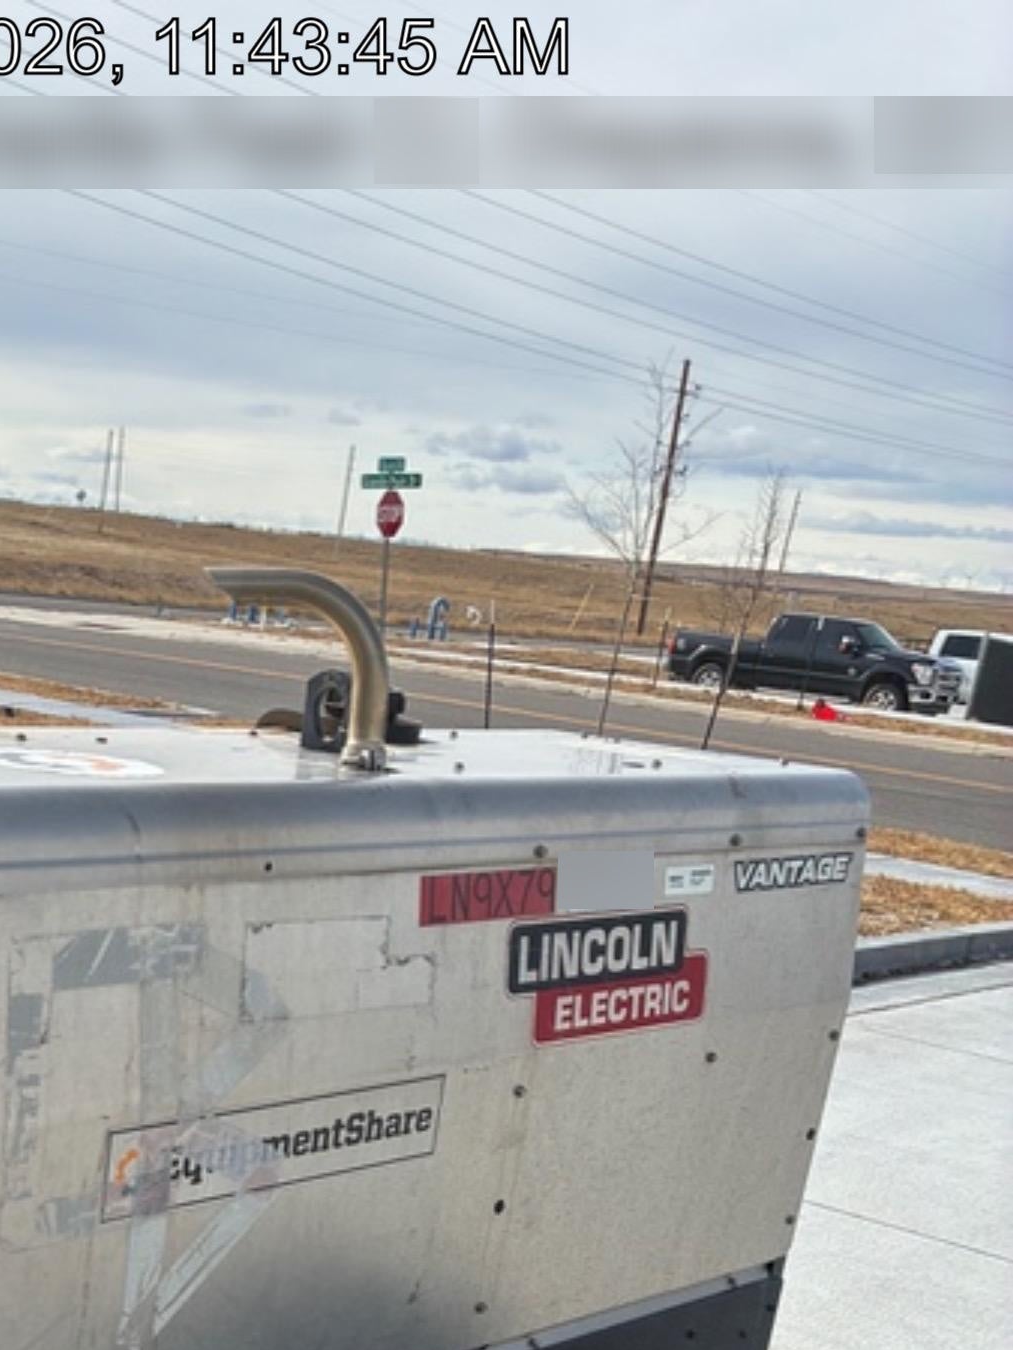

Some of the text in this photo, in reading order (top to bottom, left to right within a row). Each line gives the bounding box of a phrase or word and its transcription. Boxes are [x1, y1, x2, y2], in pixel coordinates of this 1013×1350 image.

[428, 867, 555, 924] LN9X79
[735, 855, 851, 892] VANTAGE
[517, 920, 678, 984] LINCOLN
[554, 980, 690, 1031] ELECTRIC
